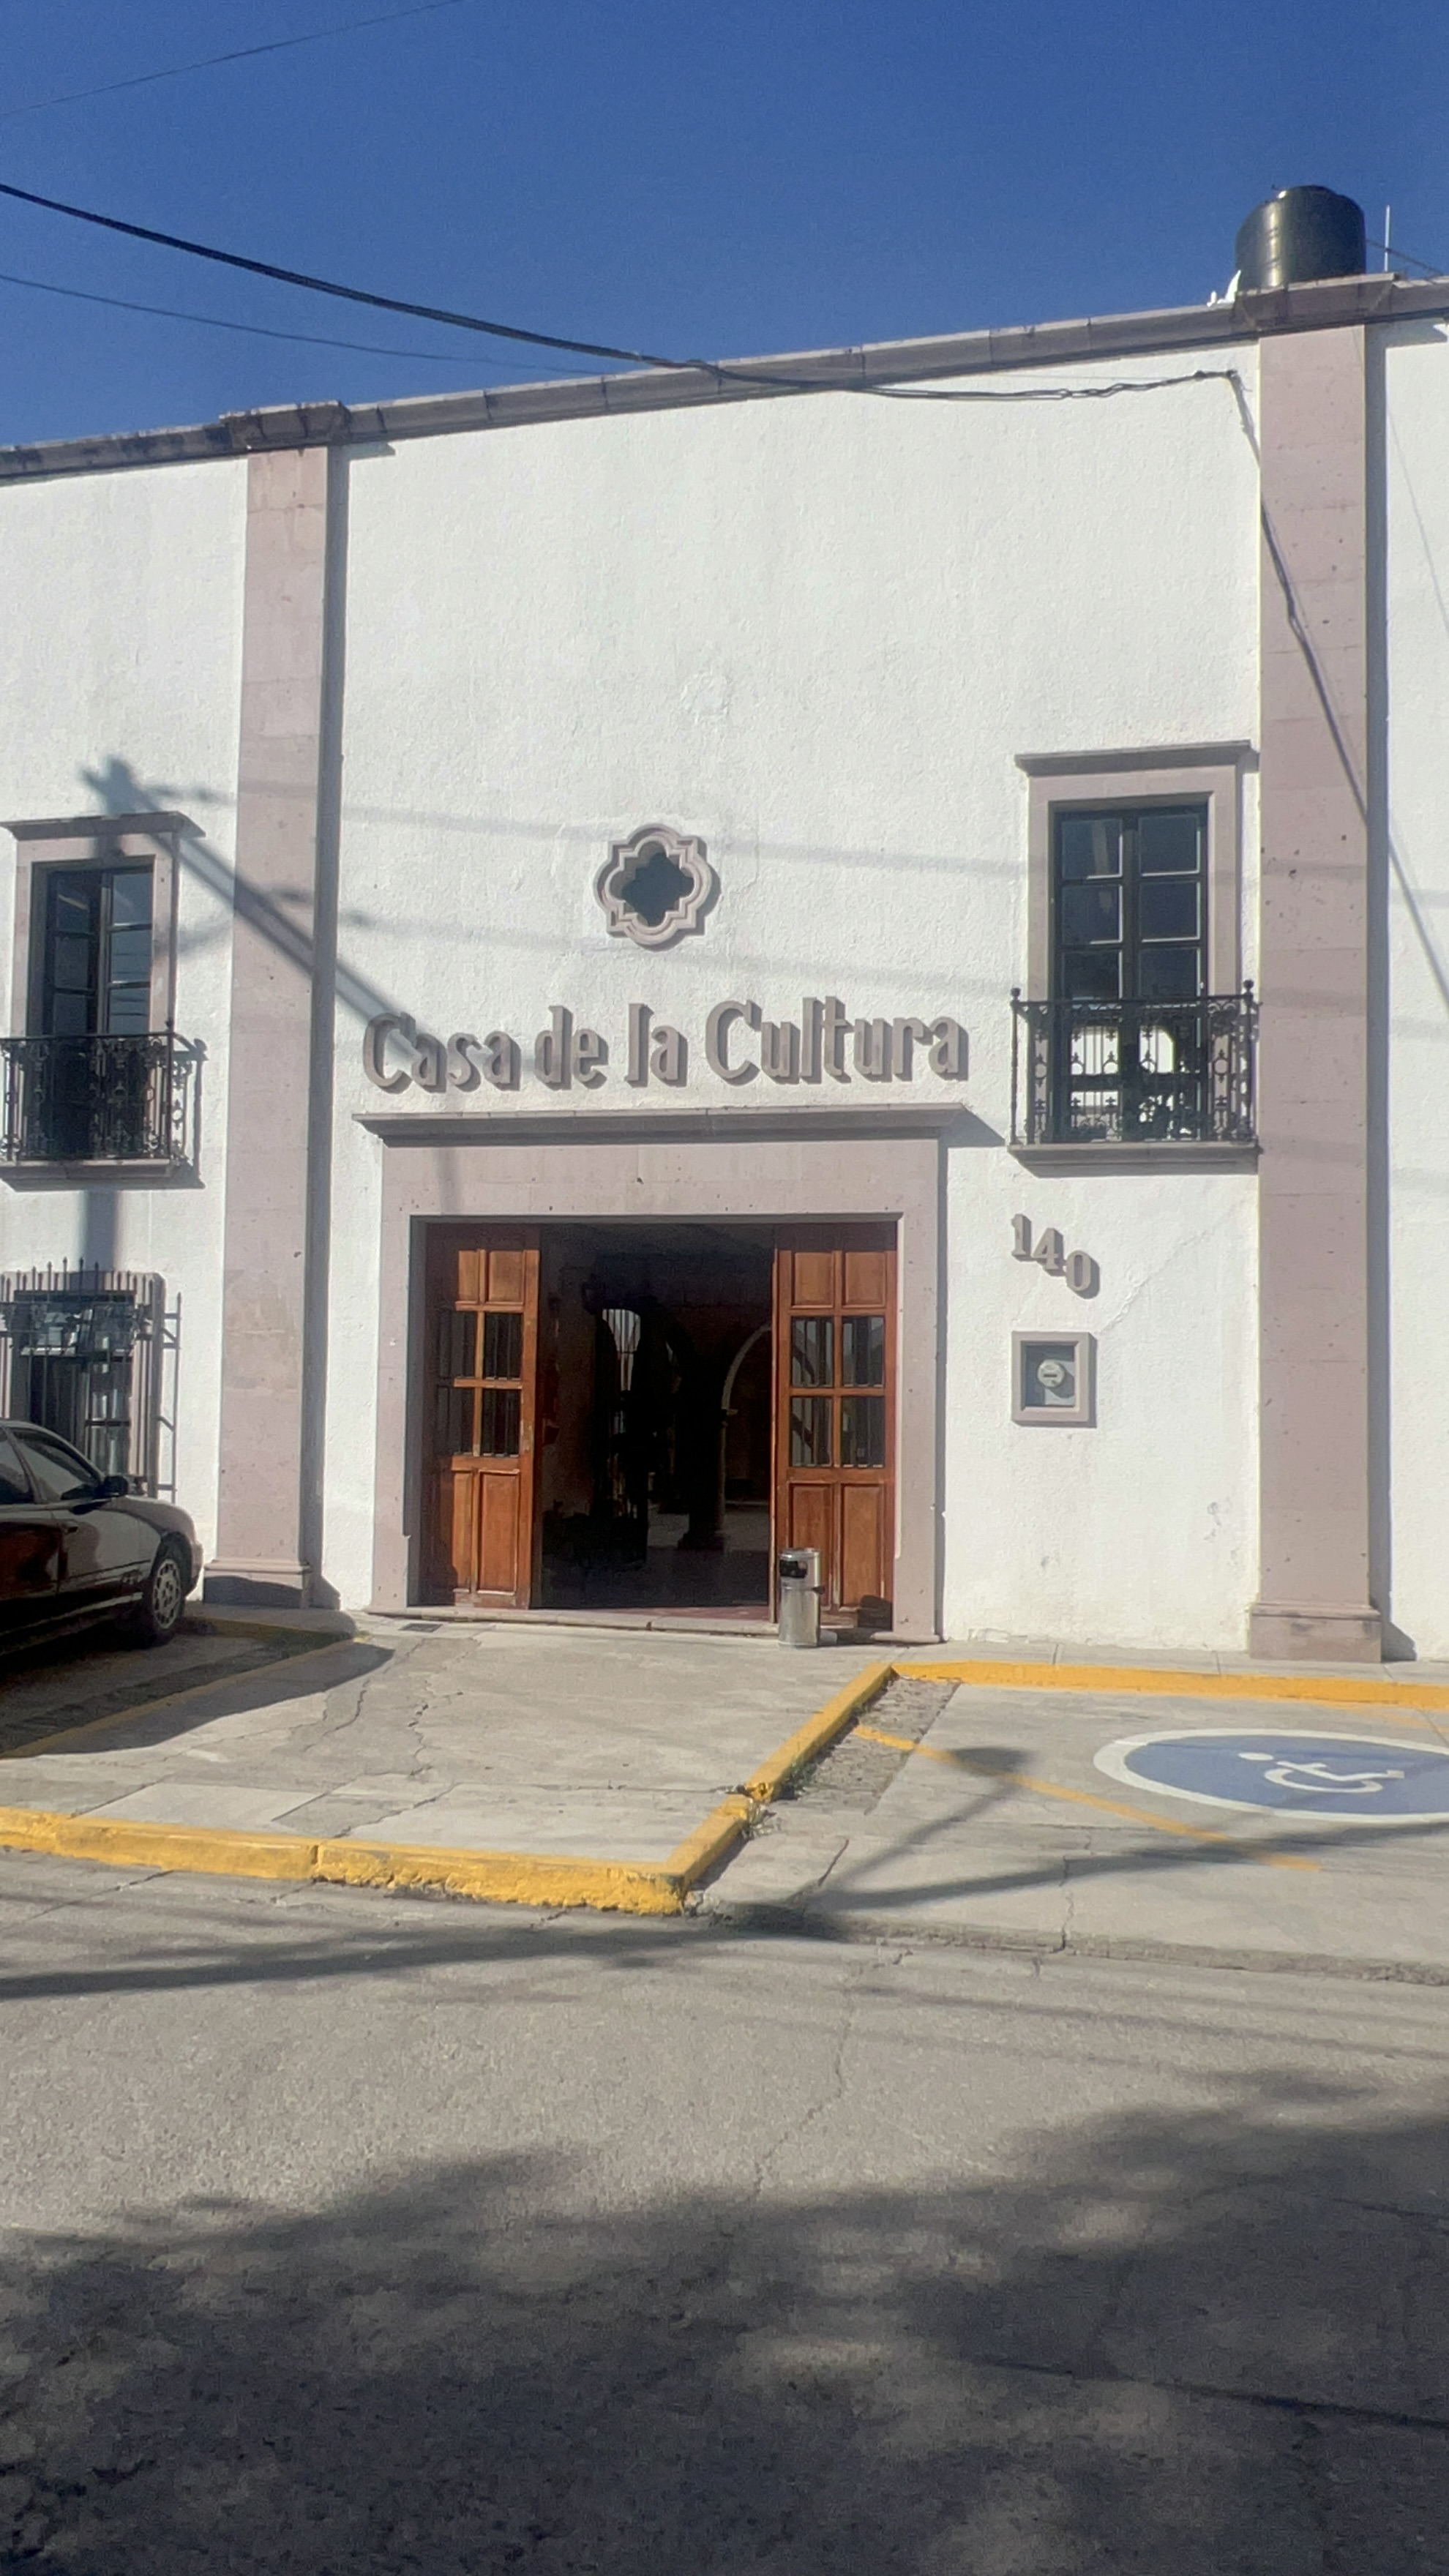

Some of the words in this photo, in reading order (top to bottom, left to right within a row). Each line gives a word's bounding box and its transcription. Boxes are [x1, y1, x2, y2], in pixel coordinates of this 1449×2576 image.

[363, 1012, 519, 1093] Casa
[534, 1006, 607, 1089] de
[624, 1003, 686, 1086] la
[705, 996, 967, 1085] Cultura
[1011, 1213, 1098, 1297] 140
